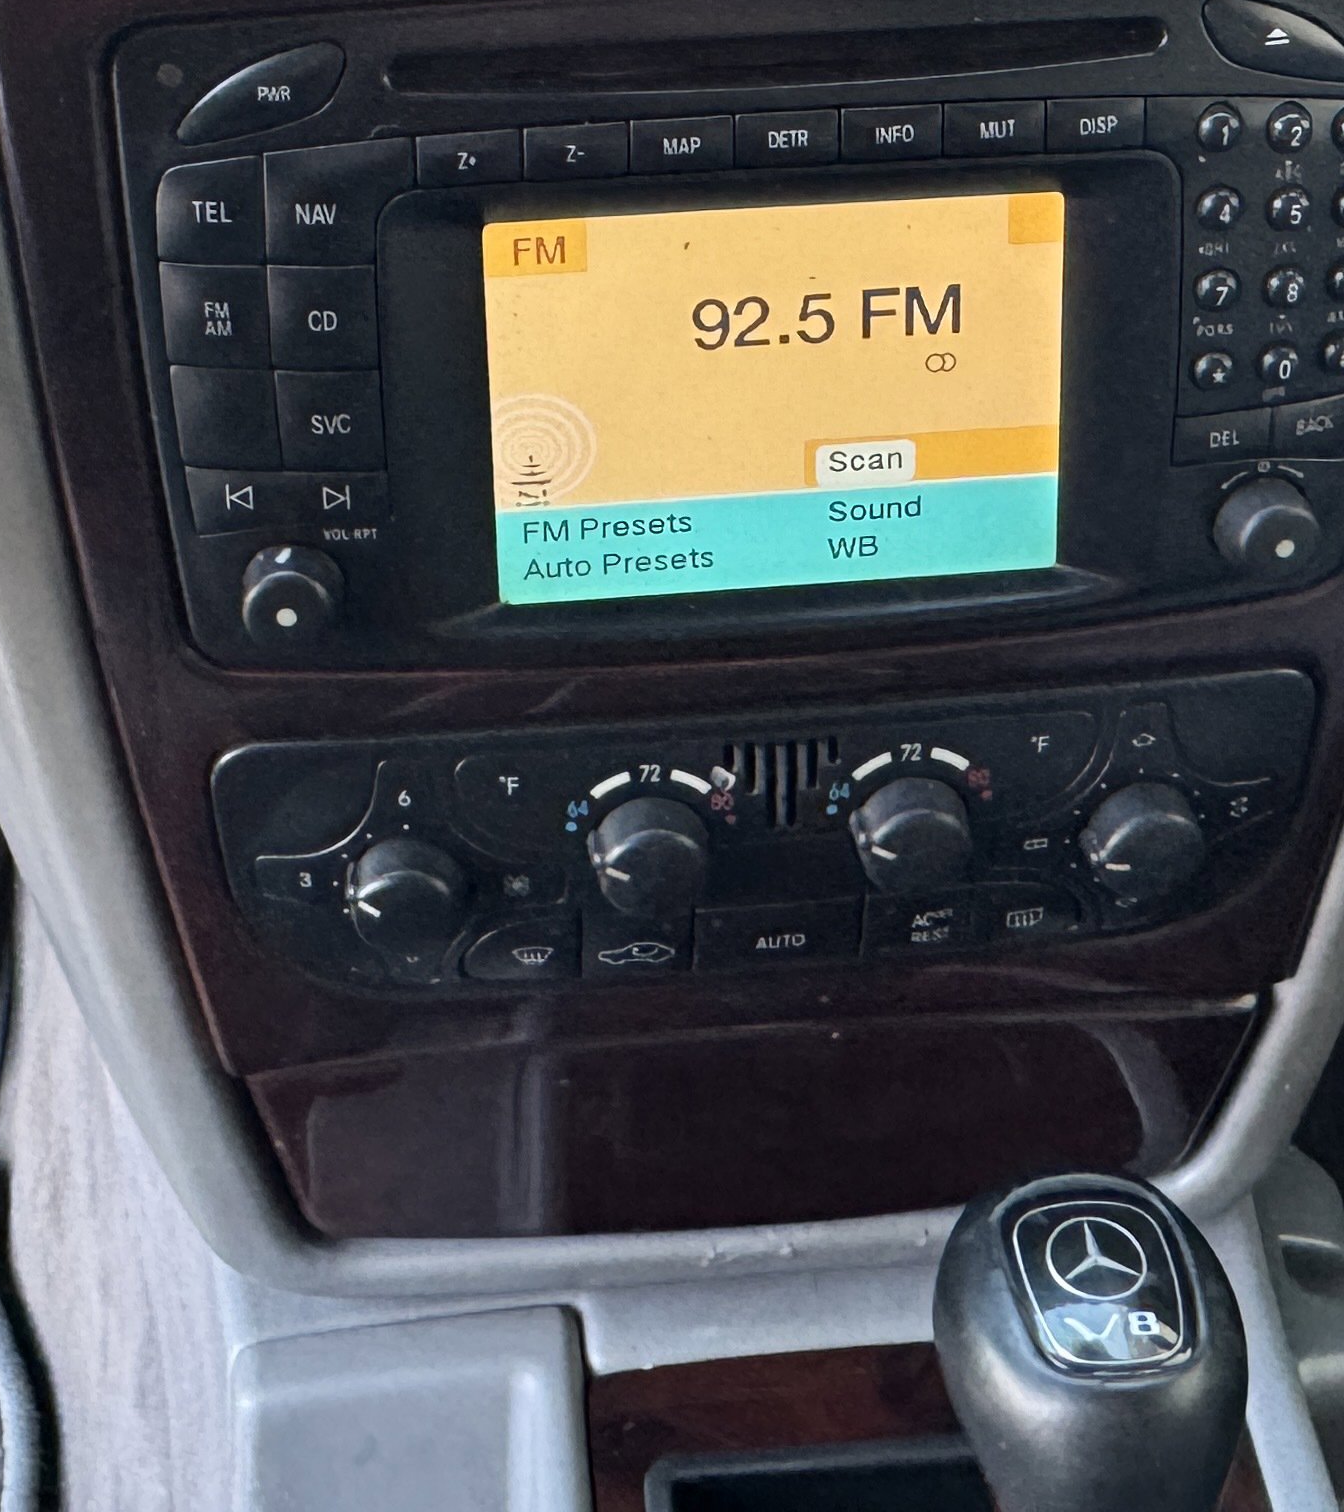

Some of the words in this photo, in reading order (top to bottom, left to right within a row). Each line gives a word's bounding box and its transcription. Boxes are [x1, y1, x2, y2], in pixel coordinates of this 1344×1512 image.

[256, 85, 292, 102] PWR
[875, 124, 915, 145] INFO
[979, 118, 1017, 139] MUT
[1079, 114, 1119, 136] DISP
[1221, 124, 1230, 146] 1
[662, 136, 702, 156] MAP
[767, 129, 809, 150] DETR
[1289, 125, 1303, 147] 2
[191, 200, 233, 224] TEL
[294, 203, 337, 226] NAV
[1218, 203, 1231, 225] 4
[1289, 204, 1303, 225] 5
[512, 236, 567, 267] FM
[1214, 285, 1229, 306] 7
[1286, 282, 1299, 303] 8
[204, 301, 230, 319] FM
[691, 292, 836, 351] 92.5
[861, 283, 962, 340] FM
[204, 320, 233, 337] AM
[307, 310, 338, 332] CD
[1278, 359, 1292, 380] 0
[310, 413, 352, 435] SVC
[1209, 430, 1240, 449] DEL
[828, 448, 904, 473] Scan
[827, 494, 923, 523] Sound
[522, 519, 570, 544] FM
[579, 512, 693, 541] Presets
[827, 534, 880, 560] WB
[522, 557, 592, 581] Auto
[602, 546, 715, 575] Presets
[899, 742, 923, 762] 72
[638, 764, 661, 783] 72
[397, 789, 412, 807] 6
[299, 871, 313, 889] 3
[755, 933, 806, 950] AUTO
[1063, 1310, 1161, 1341] V8
